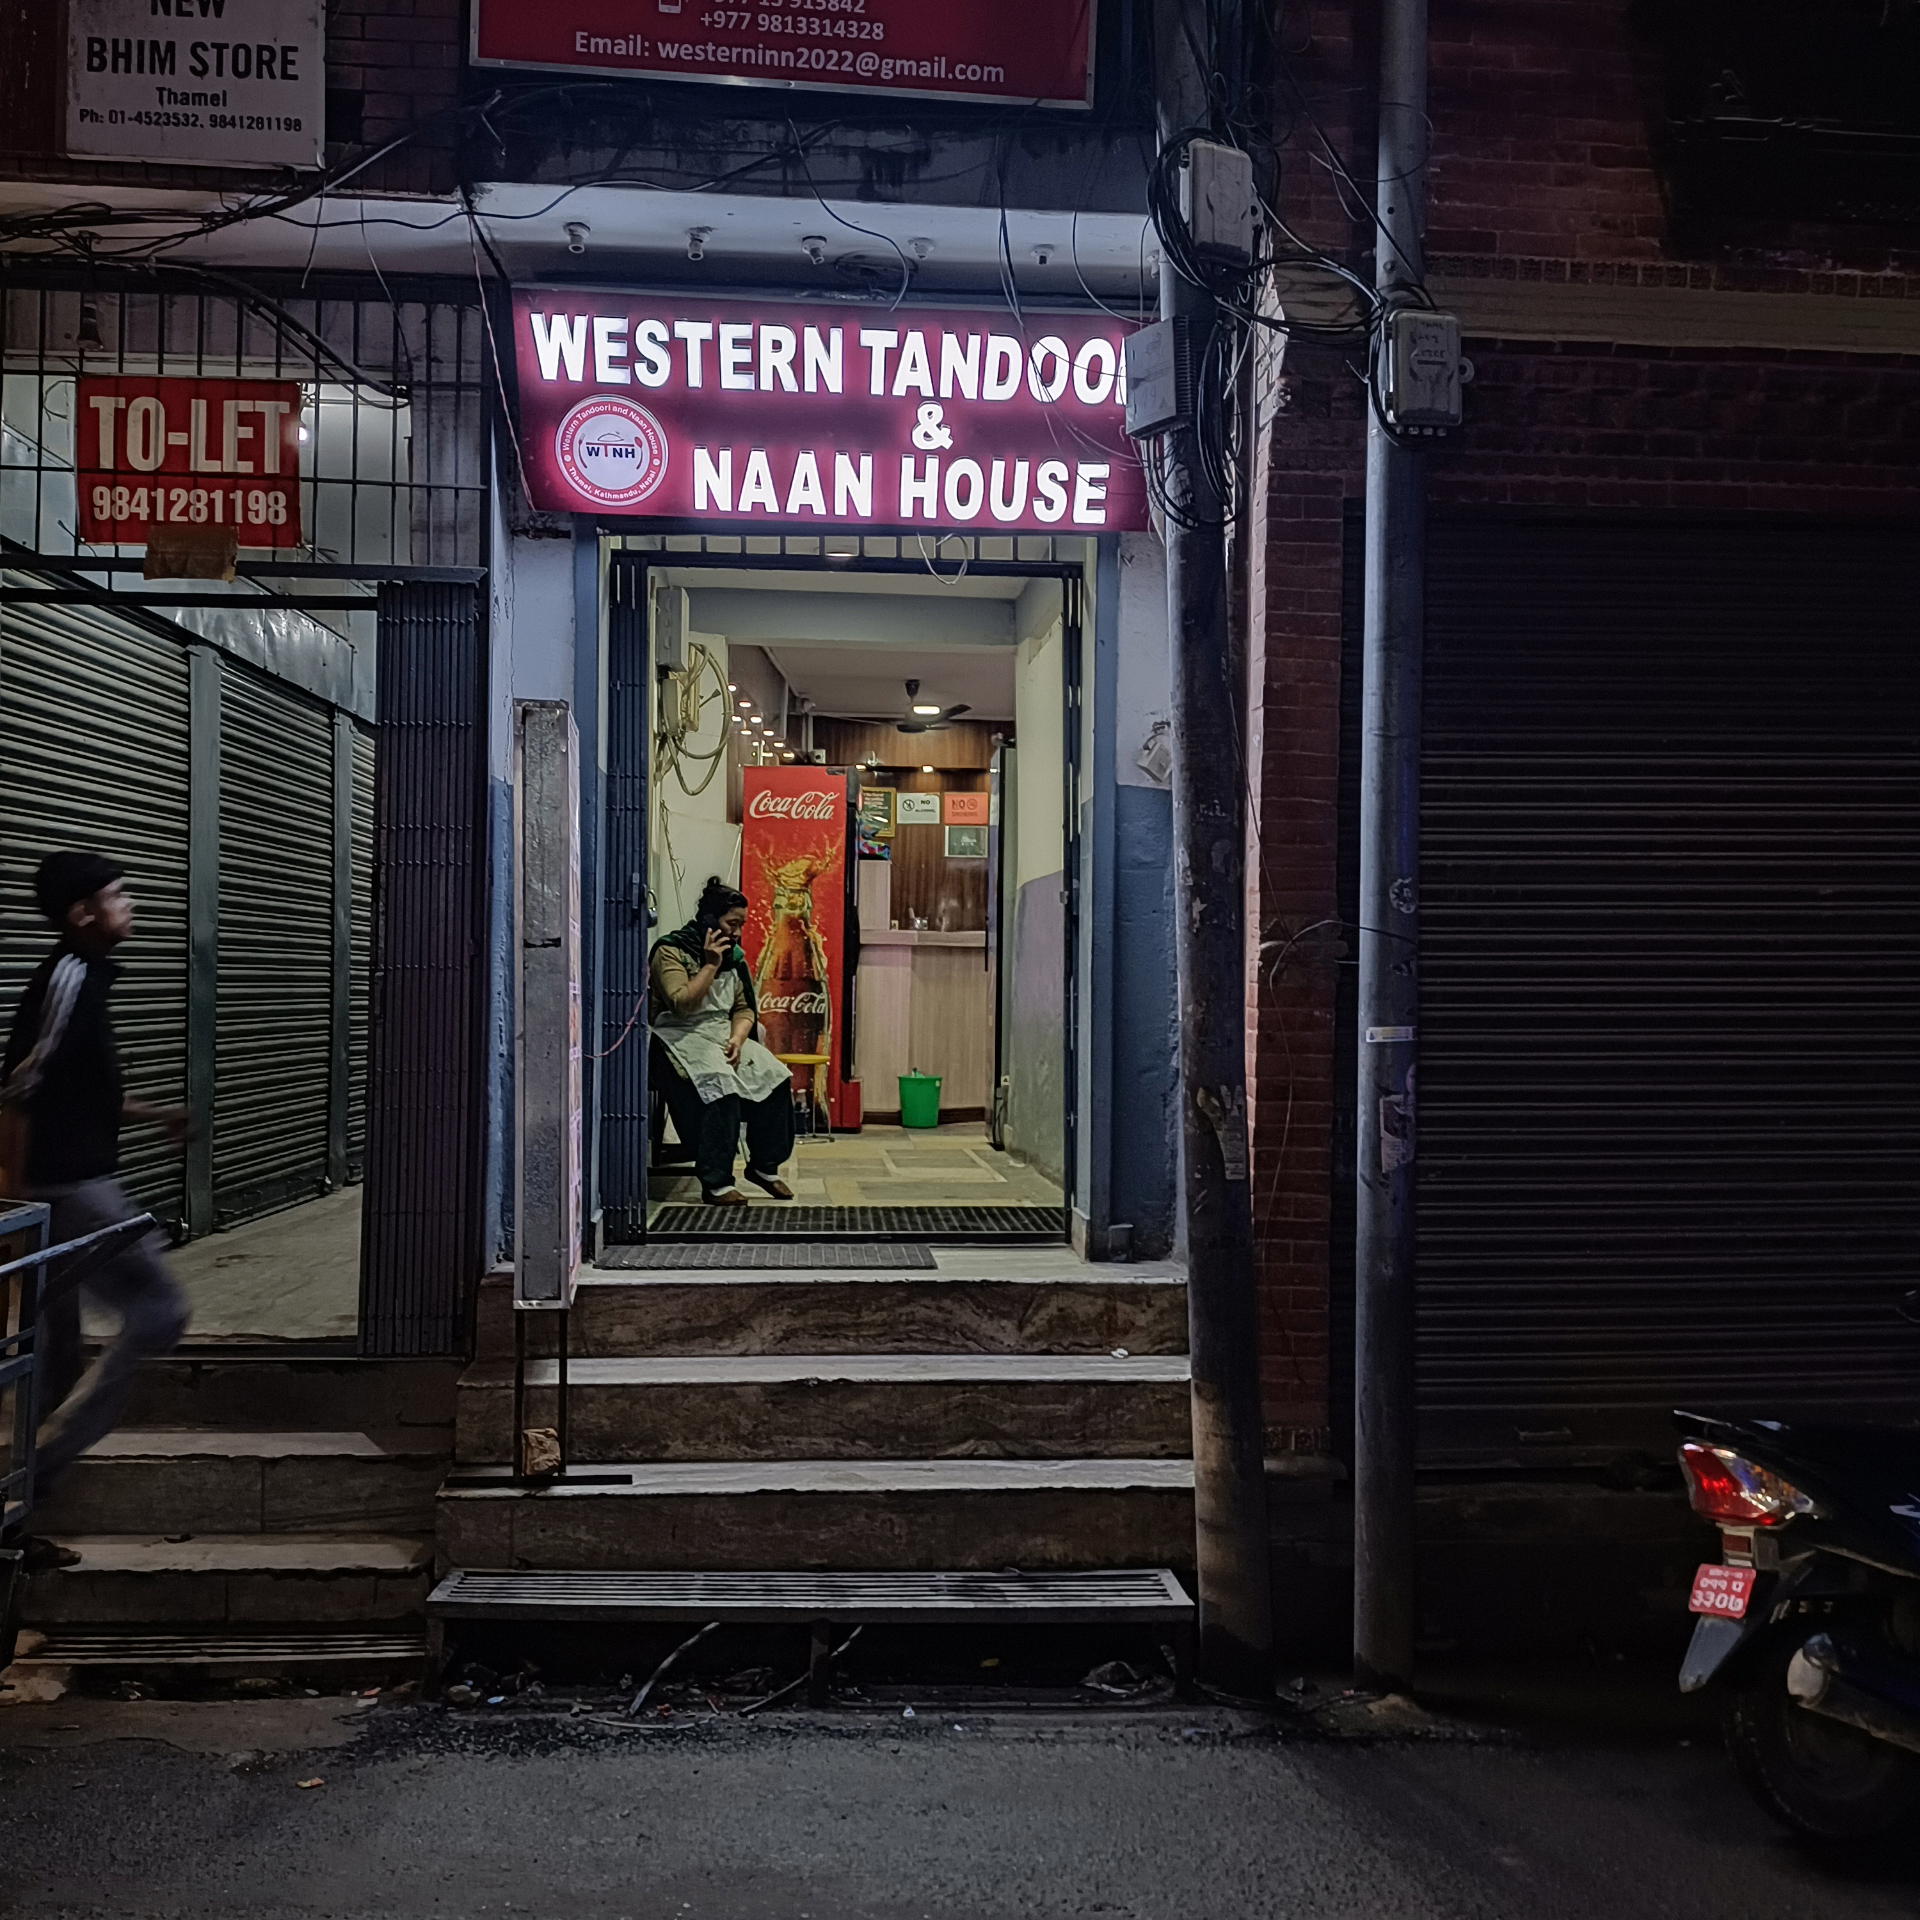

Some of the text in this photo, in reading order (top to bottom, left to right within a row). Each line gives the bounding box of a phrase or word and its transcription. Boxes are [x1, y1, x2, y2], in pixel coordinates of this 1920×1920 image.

[701, 10, 884, 40] +977 9813314328
[86, 36, 299, 81] BHIM STORE
[575, 31, 1004, 82] Email: westerninn2022@gmail.com
[156, 86, 228, 107] Thamel
[79, 108, 104, 124] Ph:
[209, 114, 302, 132] 9841281198
[528, 311, 844, 394] WESTERN
[89, 395, 291, 474] TO-LET
[562, 404, 659, 455] Western Tandoori and Naan House
[911, 401, 954, 451] &
[639, 470, 657, 491] Nepal
[693, 445, 1110, 525] NAAN HOUSE
[92, 485, 288, 526] 9841281198
[749, 789, 840, 820] Coca-Cola
[951, 799, 966, 810] NO
[758, 991, 827, 1014] Coca-Cola
